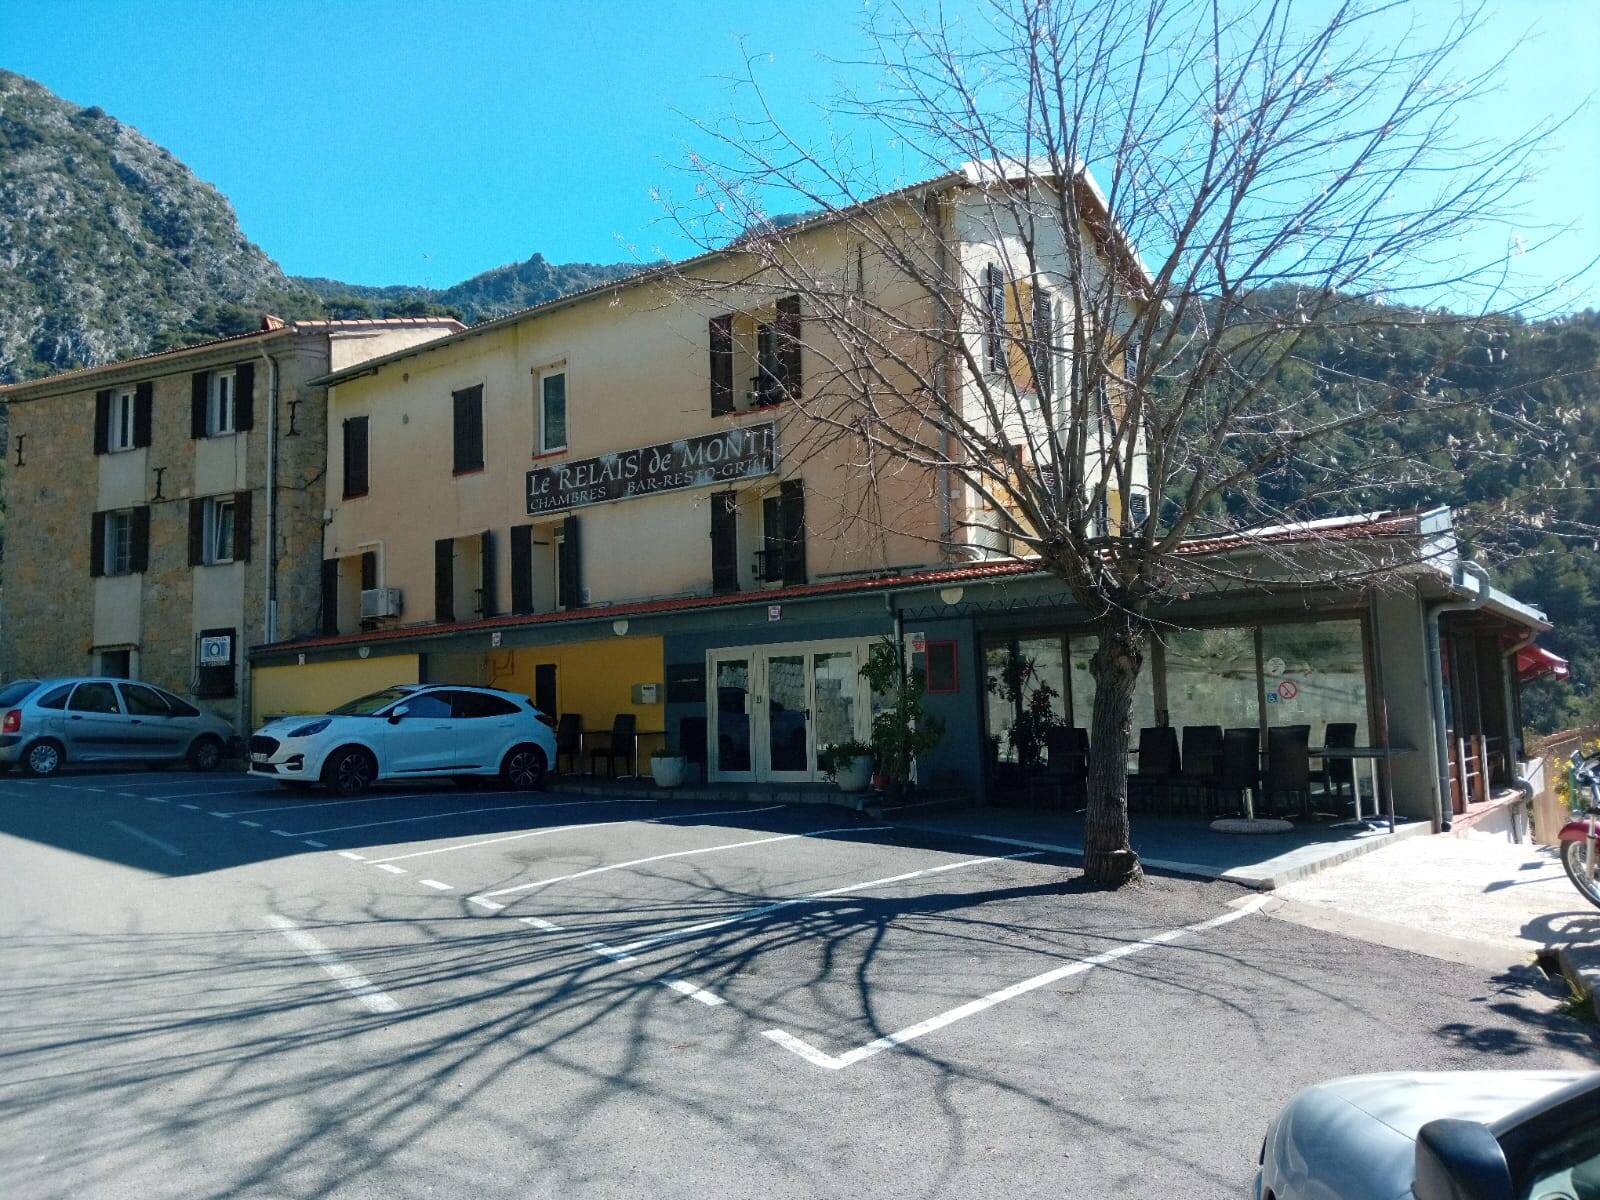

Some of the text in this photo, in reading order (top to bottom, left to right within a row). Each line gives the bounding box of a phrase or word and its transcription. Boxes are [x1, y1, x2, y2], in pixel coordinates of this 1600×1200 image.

[530, 429, 770, 496] Le RELAIS de MONTI
[530, 486, 606, 510] CHAMBRES
